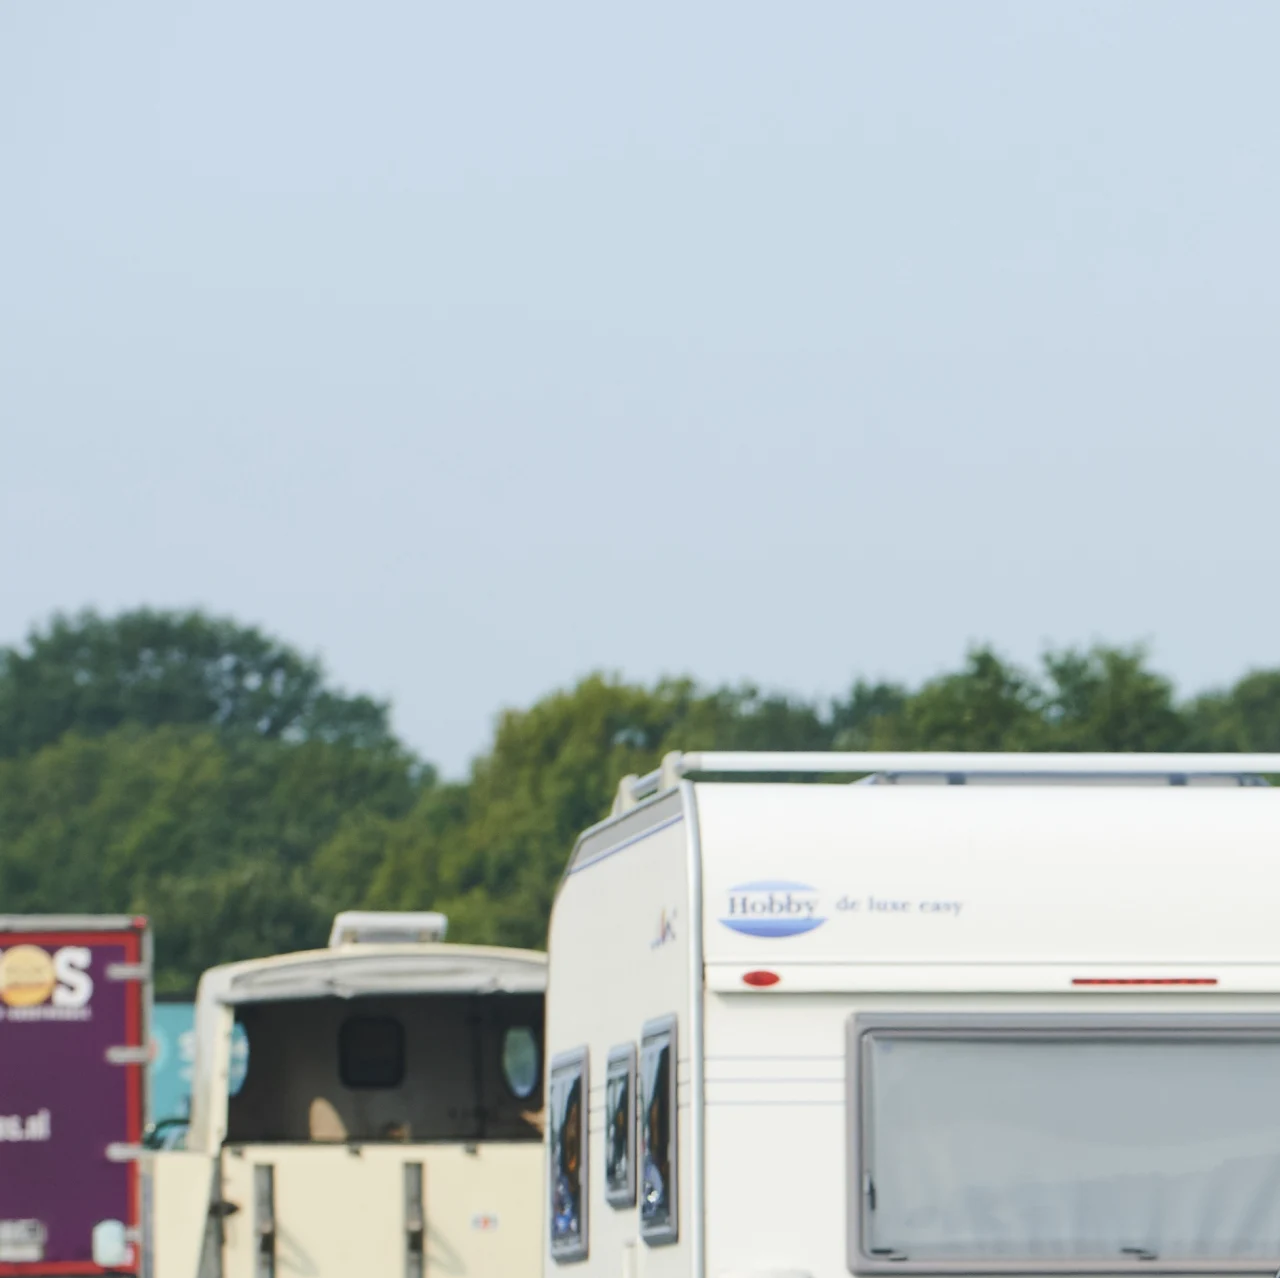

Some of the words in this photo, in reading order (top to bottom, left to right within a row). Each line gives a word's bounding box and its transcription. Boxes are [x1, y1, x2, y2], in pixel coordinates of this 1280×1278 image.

[728, 893, 818, 919] Hobby
[835, 896, 857, 912] de
[868, 896, 912, 912] luxe
[919, 900, 963, 917] easy
